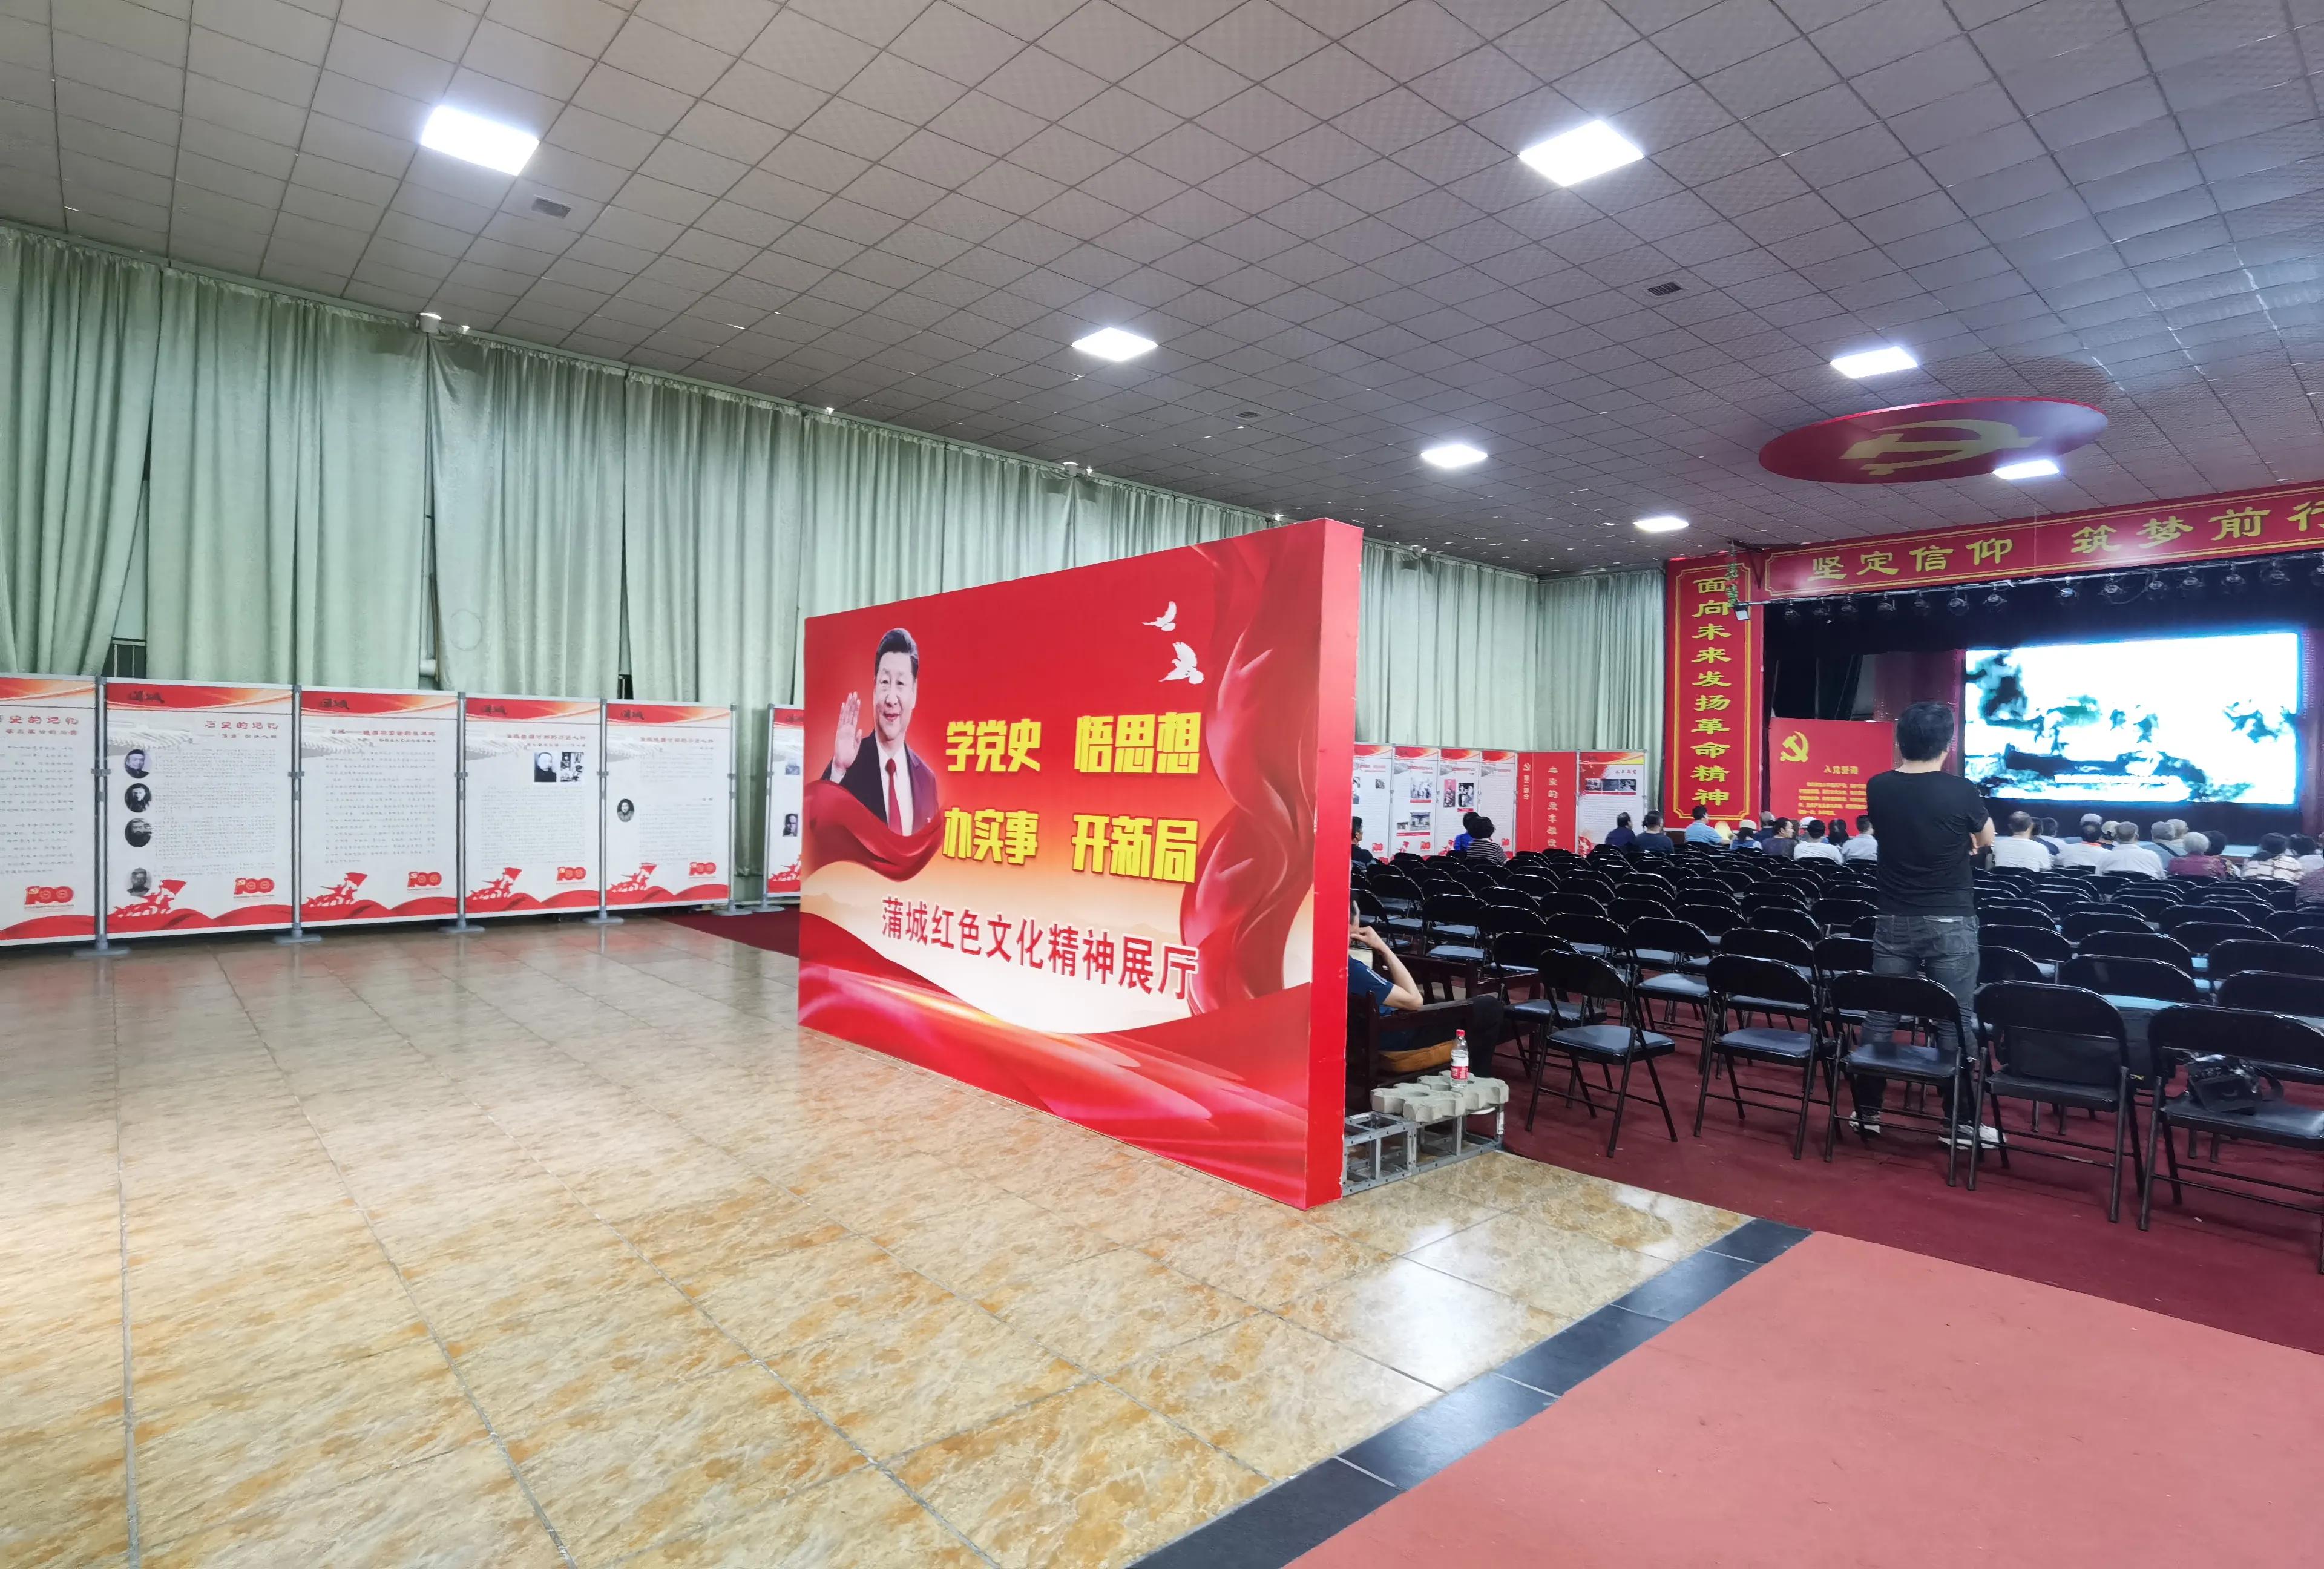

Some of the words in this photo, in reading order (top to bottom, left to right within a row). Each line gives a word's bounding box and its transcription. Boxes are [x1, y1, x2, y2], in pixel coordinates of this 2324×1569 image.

[1808, 538, 2012, 581] 坚定信仰
[2071, 501, 2324, 554] 筑梦前行
[0, 714, 79, 725] 史的记忆
[1690, 577, 1732, 806] 面向未来发扬革命精神
[945, 718, 1042, 772] 学党史
[1074, 712, 1201, 774] 悟思想
[942, 806, 1040, 866] 办实事
[1071, 813, 1199, 883] 开新局
[882, 896, 1198, 1001] 蒲城红色文化精神展厅
